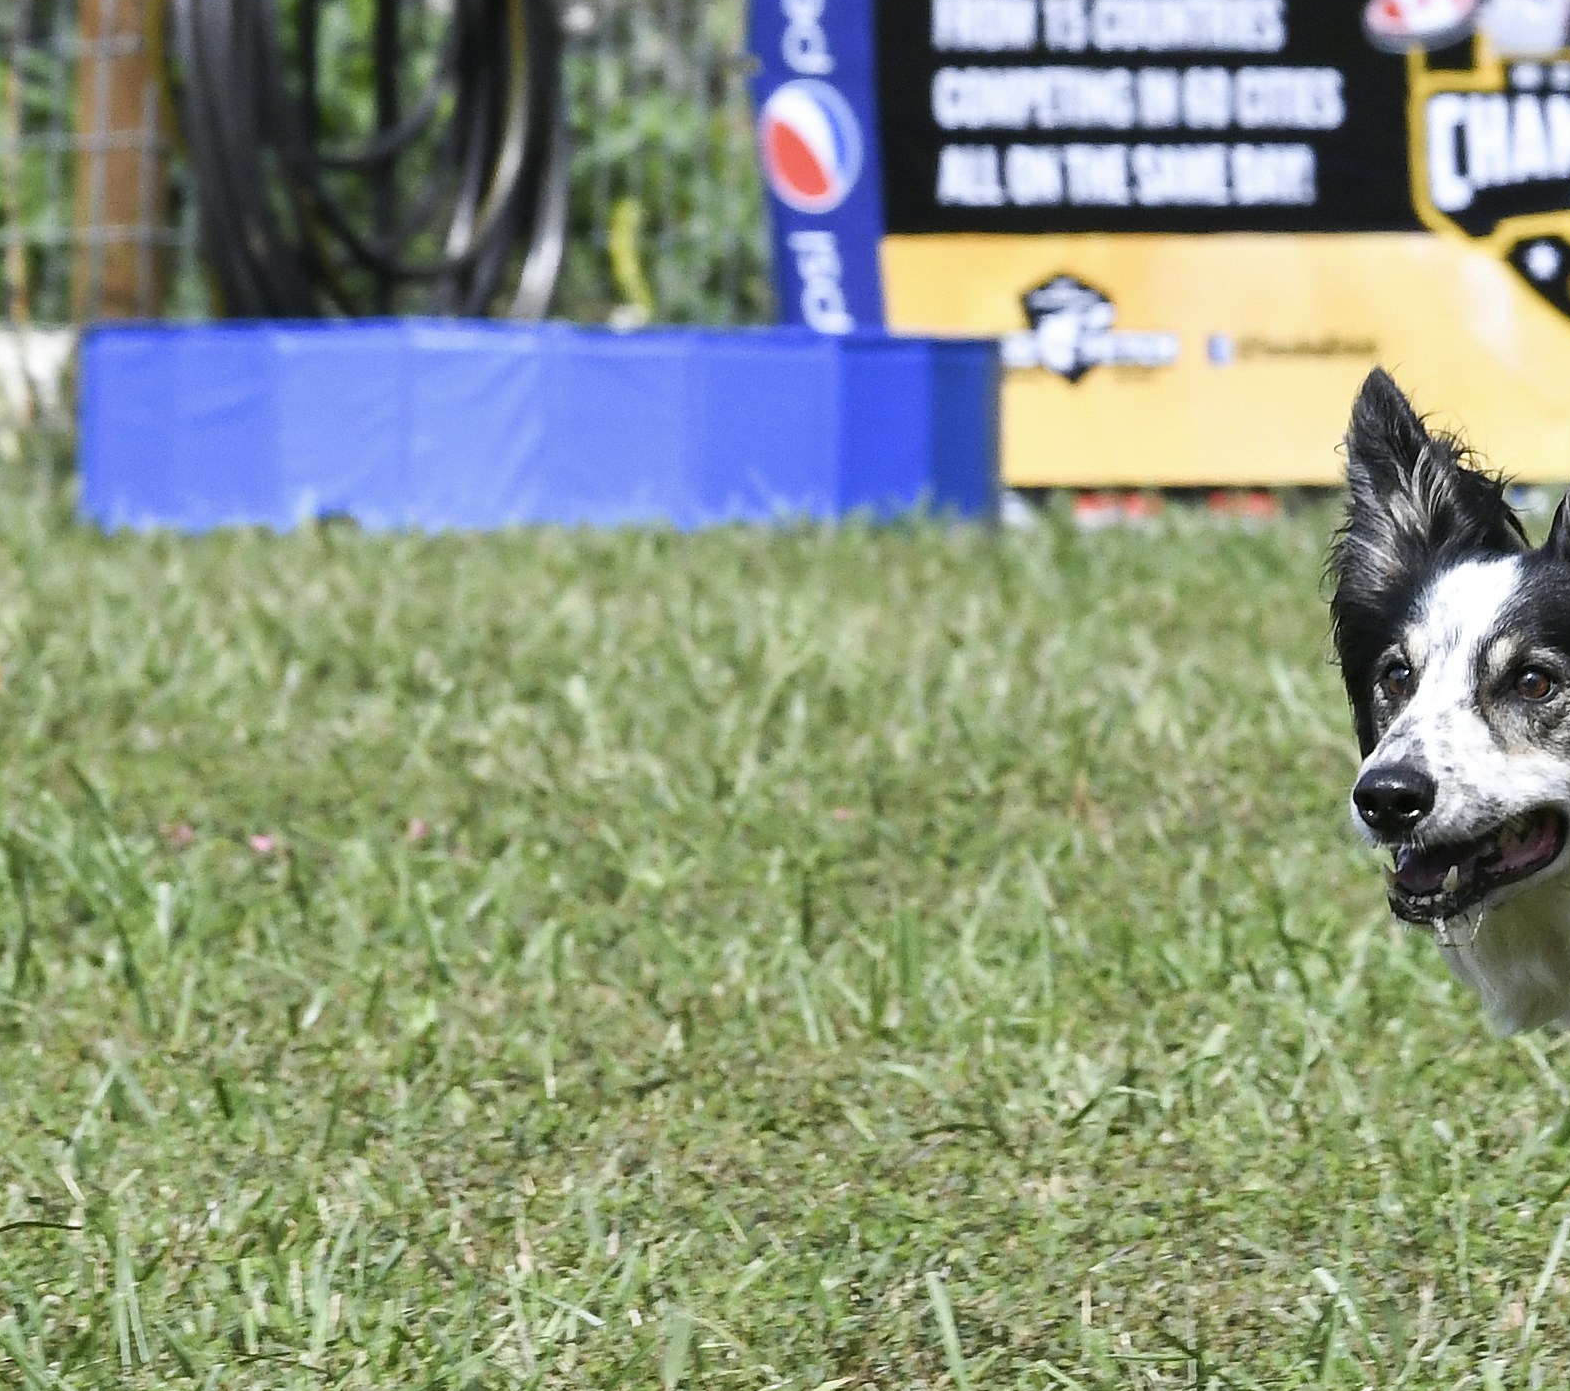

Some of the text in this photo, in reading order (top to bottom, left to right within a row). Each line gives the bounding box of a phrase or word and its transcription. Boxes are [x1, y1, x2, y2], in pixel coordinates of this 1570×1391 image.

[932, 66, 1134, 130] COMPETING
[1136, 67, 1180, 130] IN
[1235, 66, 1345, 130] CITIES
[937, 143, 1004, 207] ALL
[1004, 143, 1063, 207] ON
[1064, 143, 1130, 207] THE
[1132, 143, 1230, 207] SAME
[788, 230, 856, 335] psi
